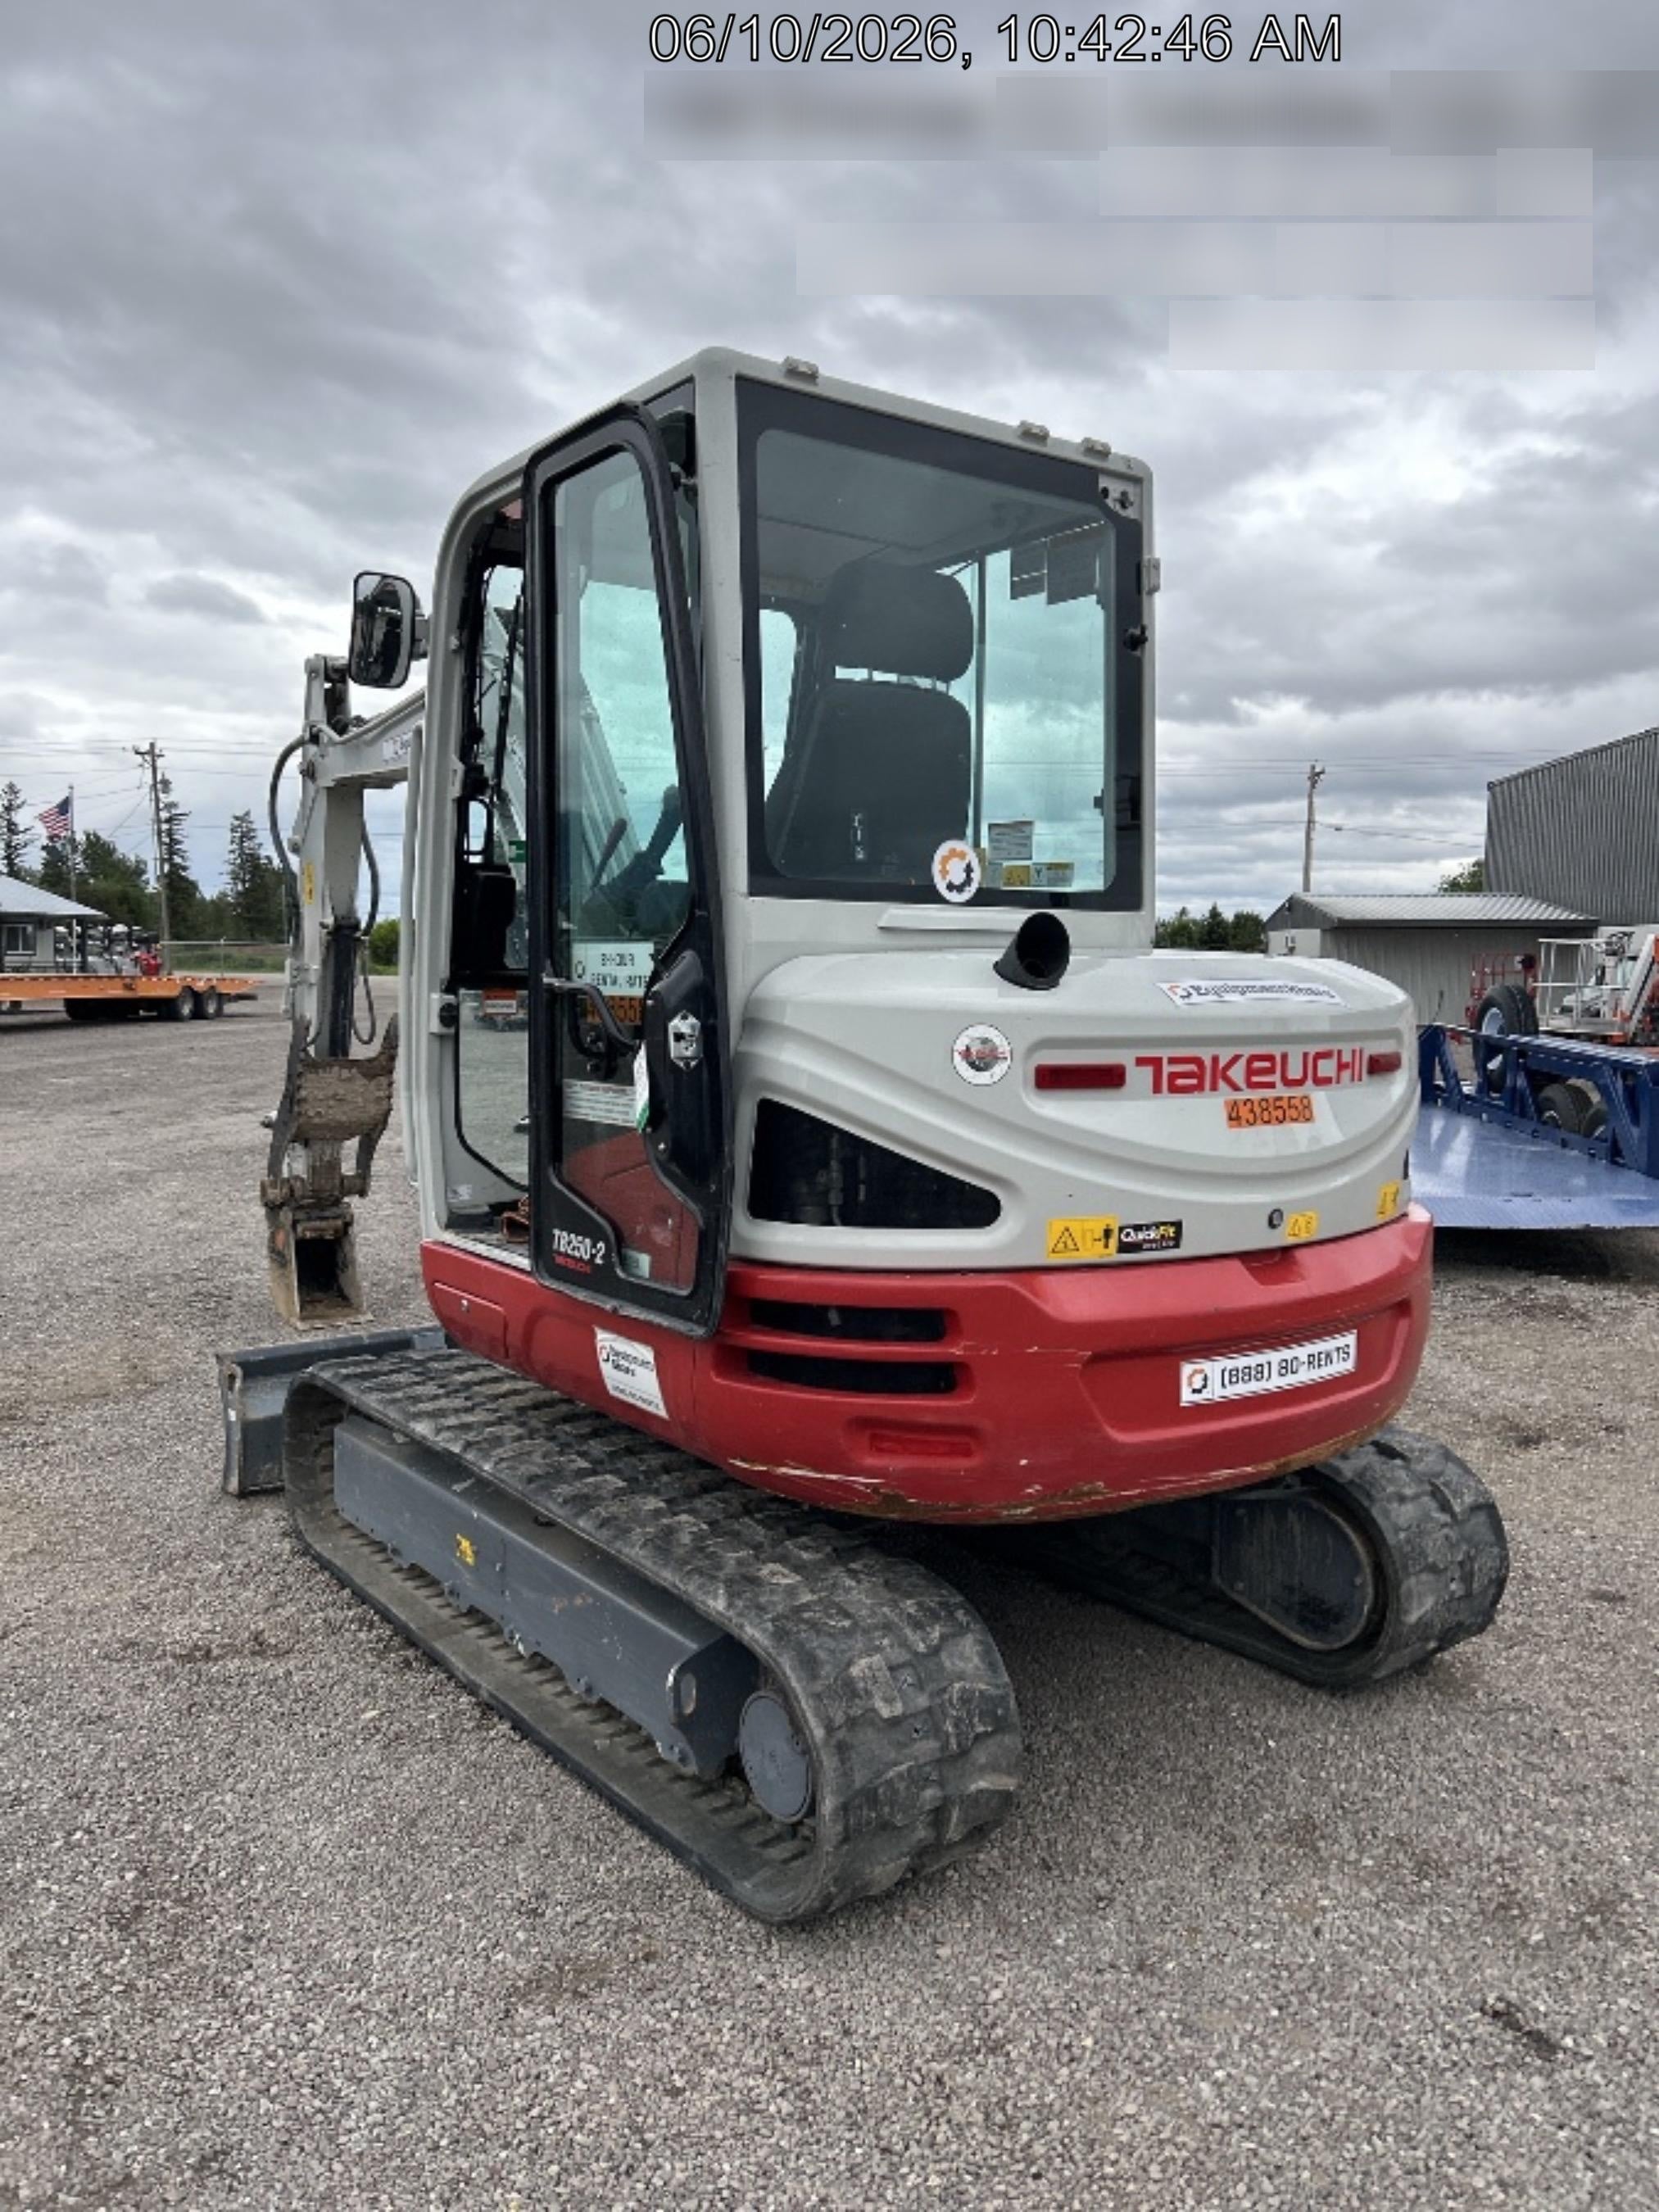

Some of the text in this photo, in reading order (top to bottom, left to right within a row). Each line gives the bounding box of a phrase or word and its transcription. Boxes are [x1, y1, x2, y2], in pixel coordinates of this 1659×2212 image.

[1135, 1048, 1363, 1095] TAKEUCHI
[1228, 1096, 1312, 1126] 438558
[552, 1228, 605, 1265] TB250-2
[1221, 1344, 1351, 1389] (888) 80-RENTS
